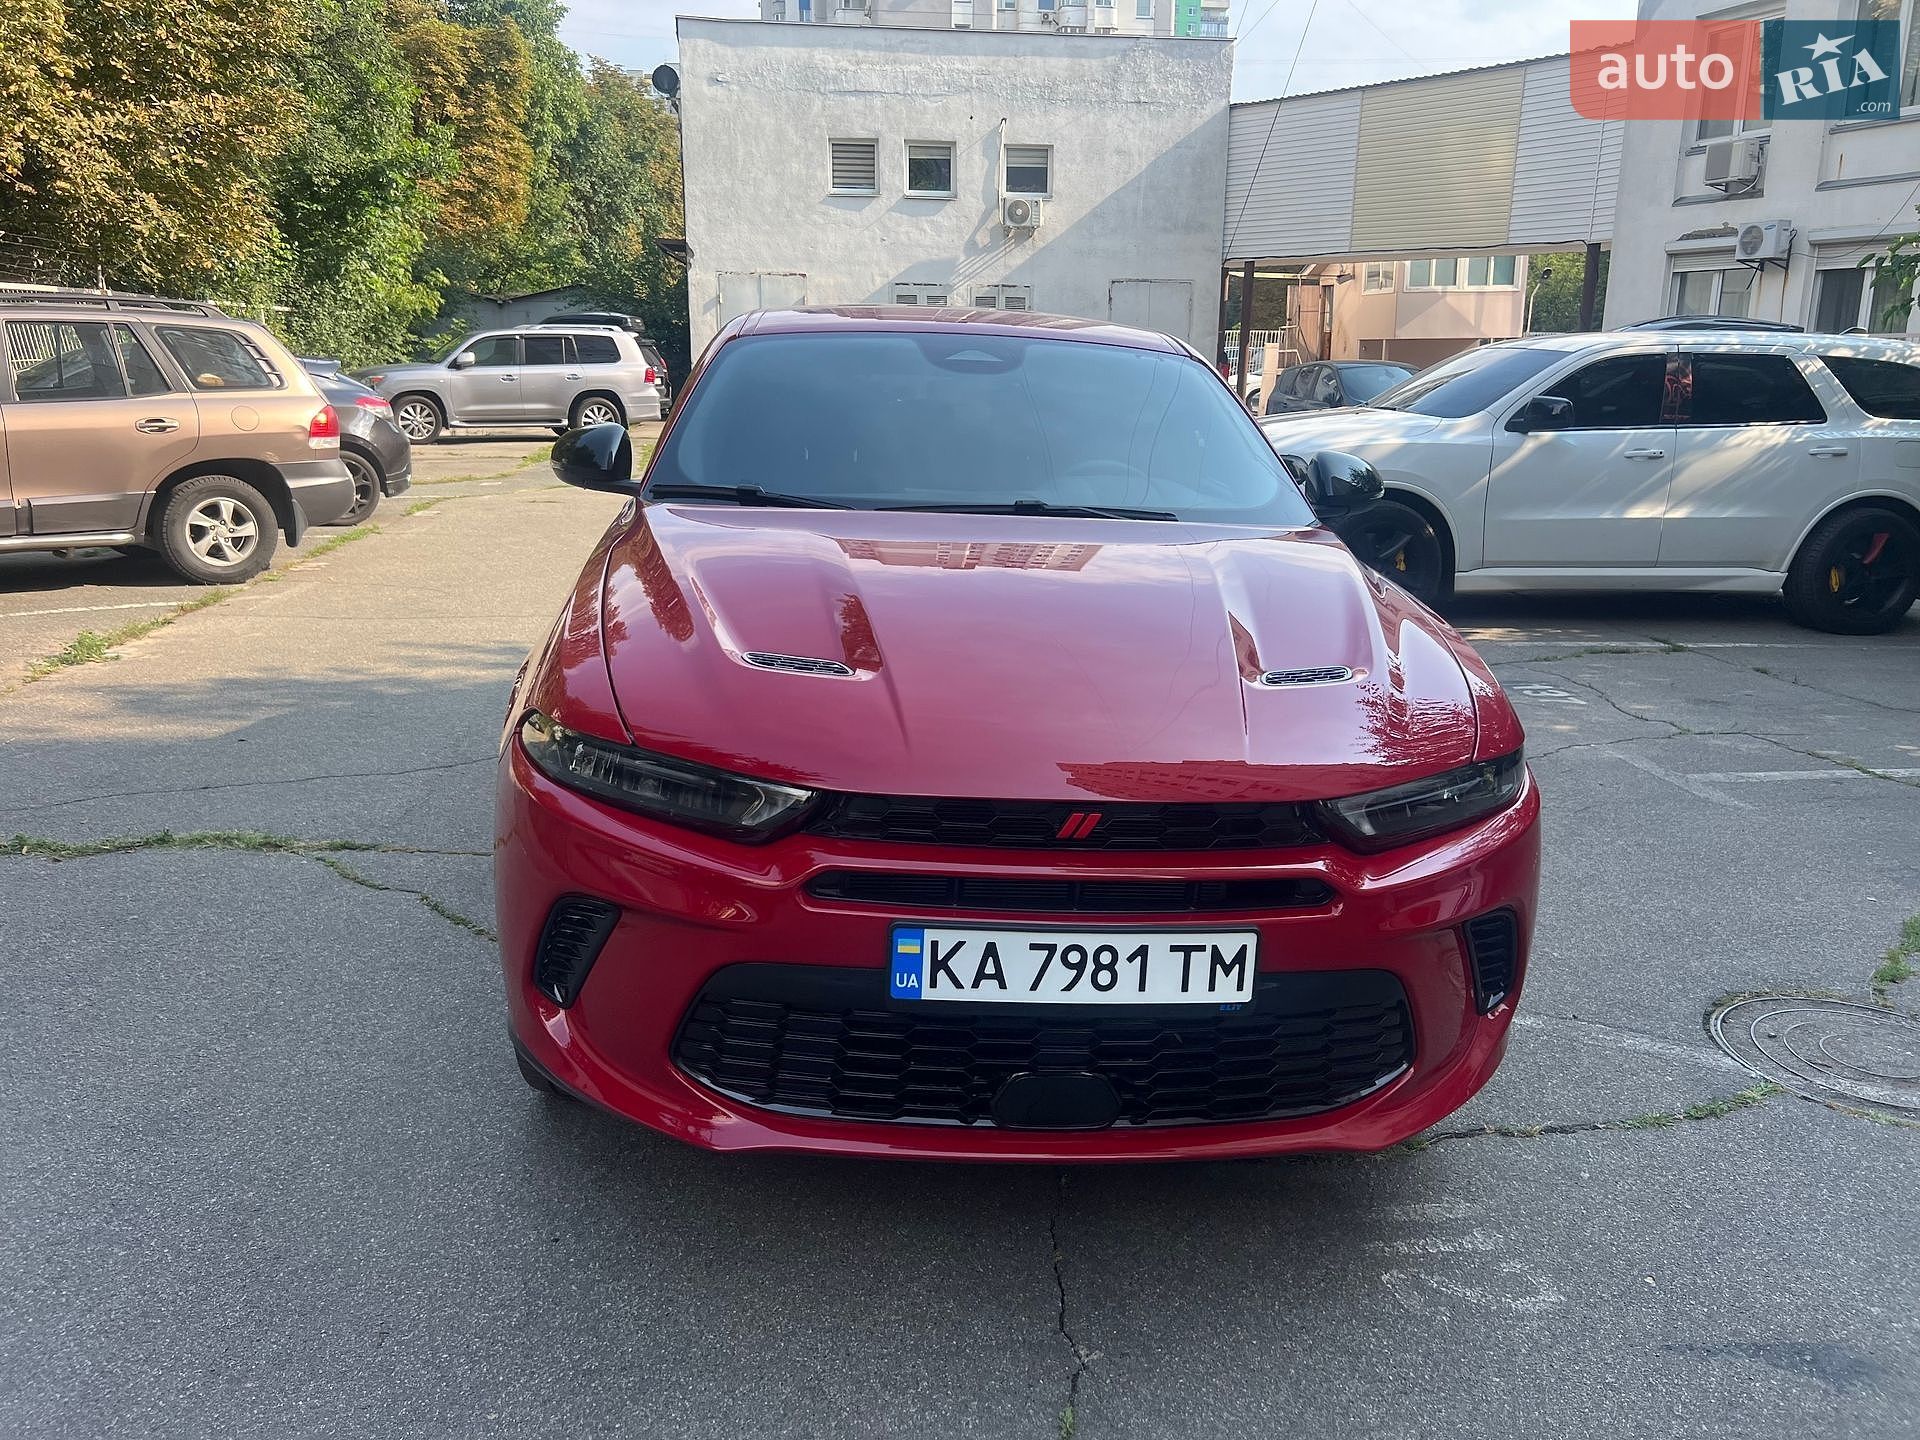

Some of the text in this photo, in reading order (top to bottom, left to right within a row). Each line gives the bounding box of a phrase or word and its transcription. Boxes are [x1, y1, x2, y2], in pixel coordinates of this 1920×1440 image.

[896, 973, 919, 988] UA
[929, 940, 1248, 993] KA 7981 TM
